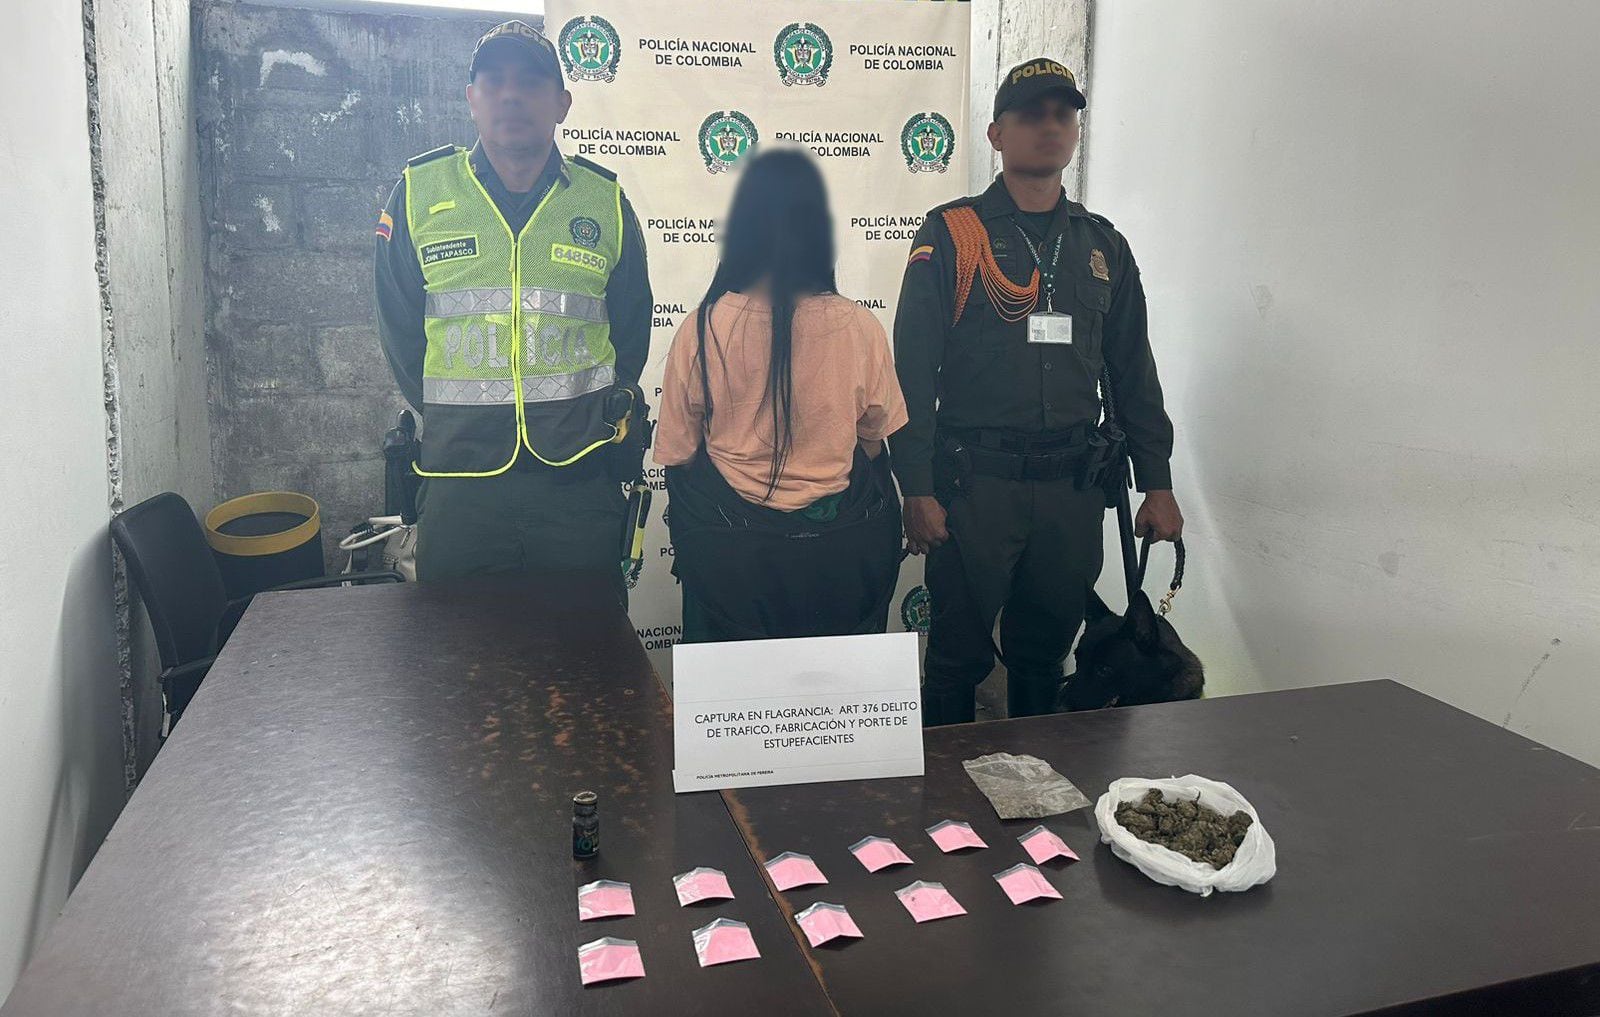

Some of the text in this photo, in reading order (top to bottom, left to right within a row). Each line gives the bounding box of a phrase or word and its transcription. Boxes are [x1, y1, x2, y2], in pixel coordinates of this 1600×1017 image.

[639, 37, 757, 54] POLICÍA NACIONAL
[849, 43, 957, 57] POLICÍA NACIONAL
[655, 54, 743, 68] DE COLOMBIA
[864, 59, 944, 71] DE COLOMBIA
[562, 128, 681, 142] POLICÍA NACIONAL
[824, 132, 884, 143] NACIONAL
[578, 143, 667, 156] DE COLOMBIA
[647, 217, 697, 230] POLICÍA
[851, 215, 897, 228] POLICÍA
[663, 232, 680, 243] DE
[865, 230, 881, 241] DE
[440, 247, 474, 259] TAPASCO
[554, 247, 606, 270] 648550
[444, 322, 596, 370] POLICIA
[637, 626, 682, 638] NACION
[694, 701, 918, 724] CAPTURA EN FLAGRANCIA: ART 376 DELITO
[706, 728, 721, 738] DE
[775, 718, 846, 733] FABRICACIÓN
[848, 719, 856, 729] Y
[858, 717, 892, 728] PORTE
[893, 715, 908, 726] DE
[764, 733, 855, 749] ESTUPEFACIENTES
